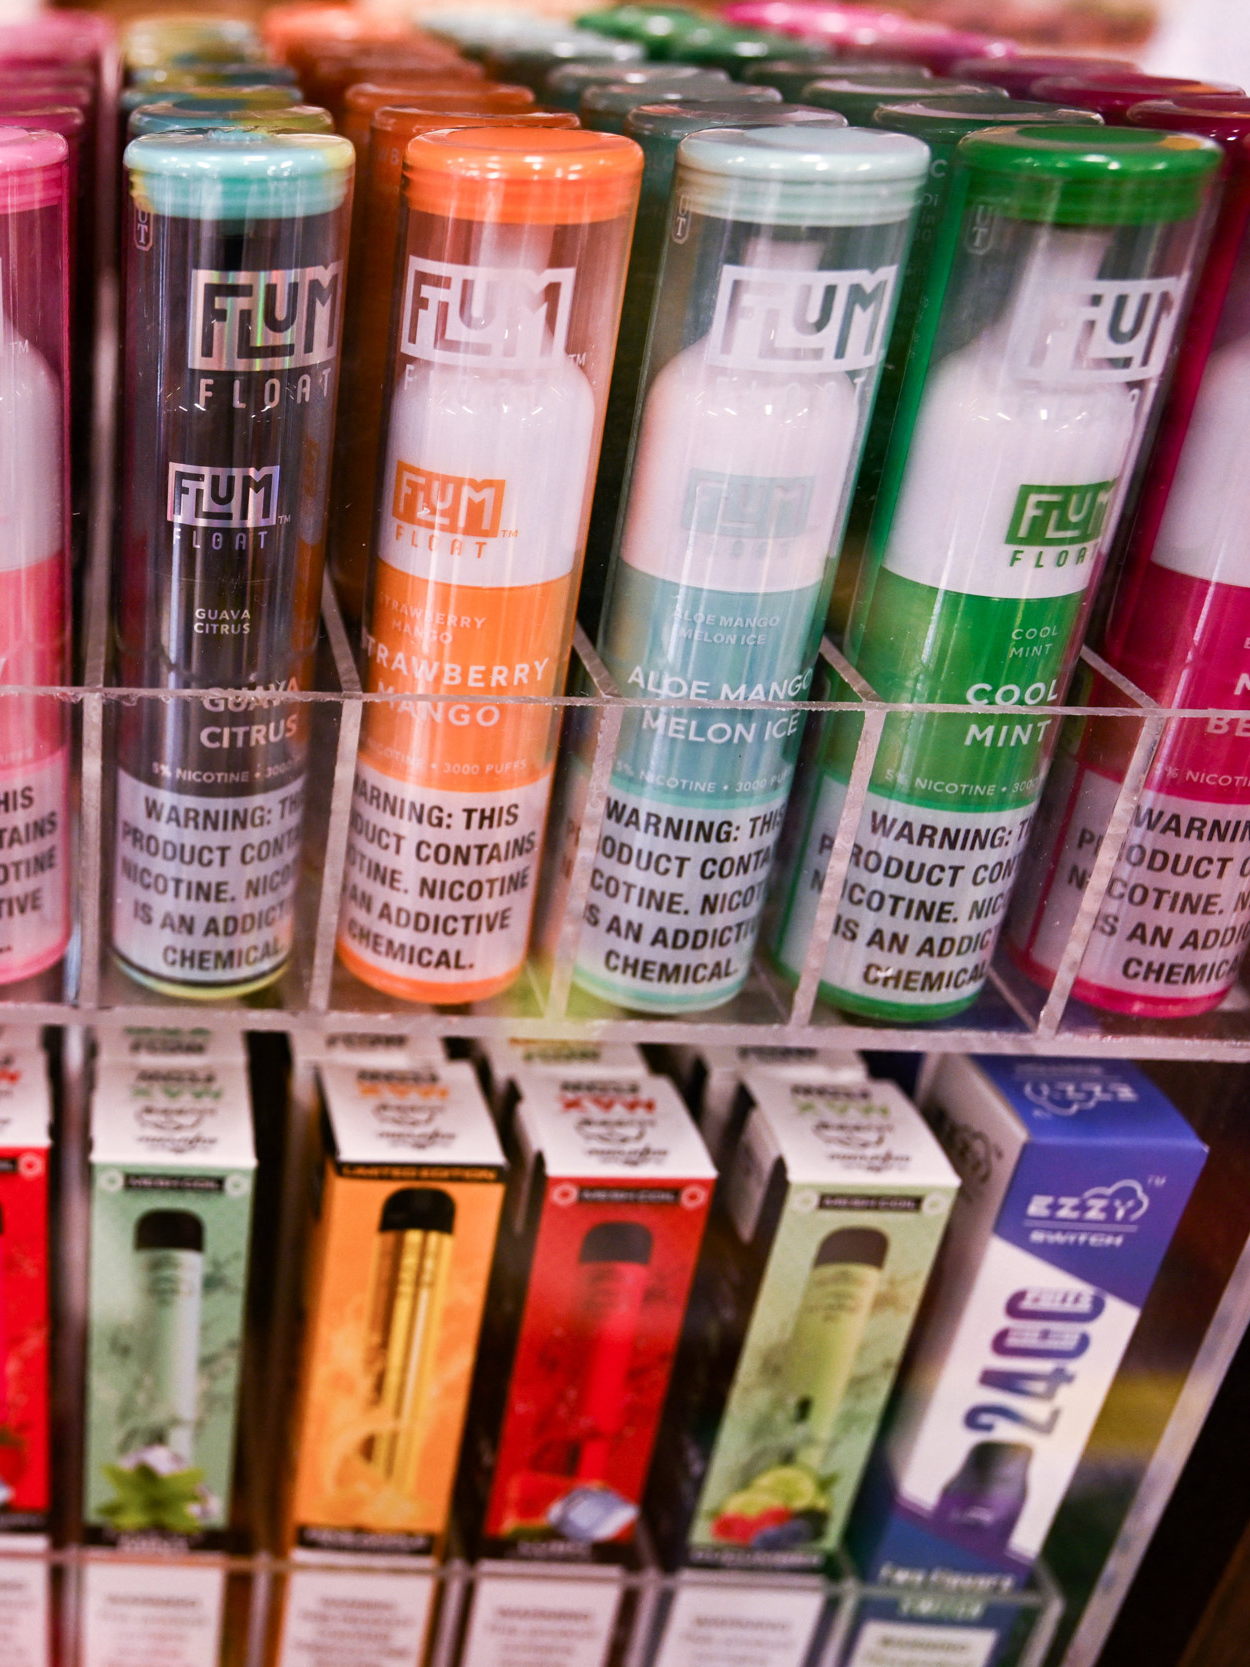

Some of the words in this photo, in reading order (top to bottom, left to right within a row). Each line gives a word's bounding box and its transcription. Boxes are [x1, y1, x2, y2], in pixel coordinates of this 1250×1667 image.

[196, 270, 340, 364] FLUM
[405, 266, 566, 361] FLUM
[718, 273, 890, 364] FLUM
[200, 368, 331, 408] FLOAT
[171, 467, 276, 524] FLUM
[398, 468, 500, 534] FLUM
[174, 528, 268, 549] FLOAT
[396, 524, 487, 559] FLOAT
[193, 622, 251, 635] CITRUS
[195, 608, 251, 622] GUAVA
[392, 619, 454, 646] MANGO
[672, 608, 716, 627] ALOE
[719, 615, 781, 628] MANGO
[678, 627, 738, 645] MELON
[740, 632, 768, 646] ICE
[1009, 643, 1053, 659] MINT
[1011, 626, 1058, 642] COOL
[627, 665, 710, 702] ALOE
[721, 667, 813, 703] MANGO
[966, 679, 1060, 708] COOL
[200, 714, 298, 749] CITRUS
[641, 709, 756, 745] MELON
[764, 711, 800, 742] ICE
[964, 719, 1052, 748] MINT
[176, 767, 250, 784] NICOTINE
[443, 761, 481, 776] 3000
[485, 757, 528, 776] PUFFS
[639, 769, 717, 793] NICOTINE
[735, 777, 768, 793] 3000
[914, 776, 997, 798] NICOTINE
[144, 796, 272, 832] WARNING:
[462, 802, 520, 831] THIS
[605, 797, 740, 844] WARNING:
[869, 810, 1013, 851] WARNING:
[121, 820, 231, 868] PRODUCT
[414, 830, 537, 868] CONTAINS
[120, 856, 236, 904] NICOTINE.
[418, 865, 531, 902] NICOTINE
[1067, 863, 1224, 916] NCOTINE.
[133, 899, 154, 927] IS
[159, 911, 195, 937] AN
[377, 896, 513, 937] ADDICTIVE
[605, 914, 644, 945] AN
[347, 916, 476, 971] CHEMICAL.
[832, 914, 860, 943] IS
[866, 927, 910, 956] AN
[1125, 920, 1174, 949] AN
[862, 962, 987, 993] CHEMICAL
[1025, 1194, 1135, 1222] EZZY
